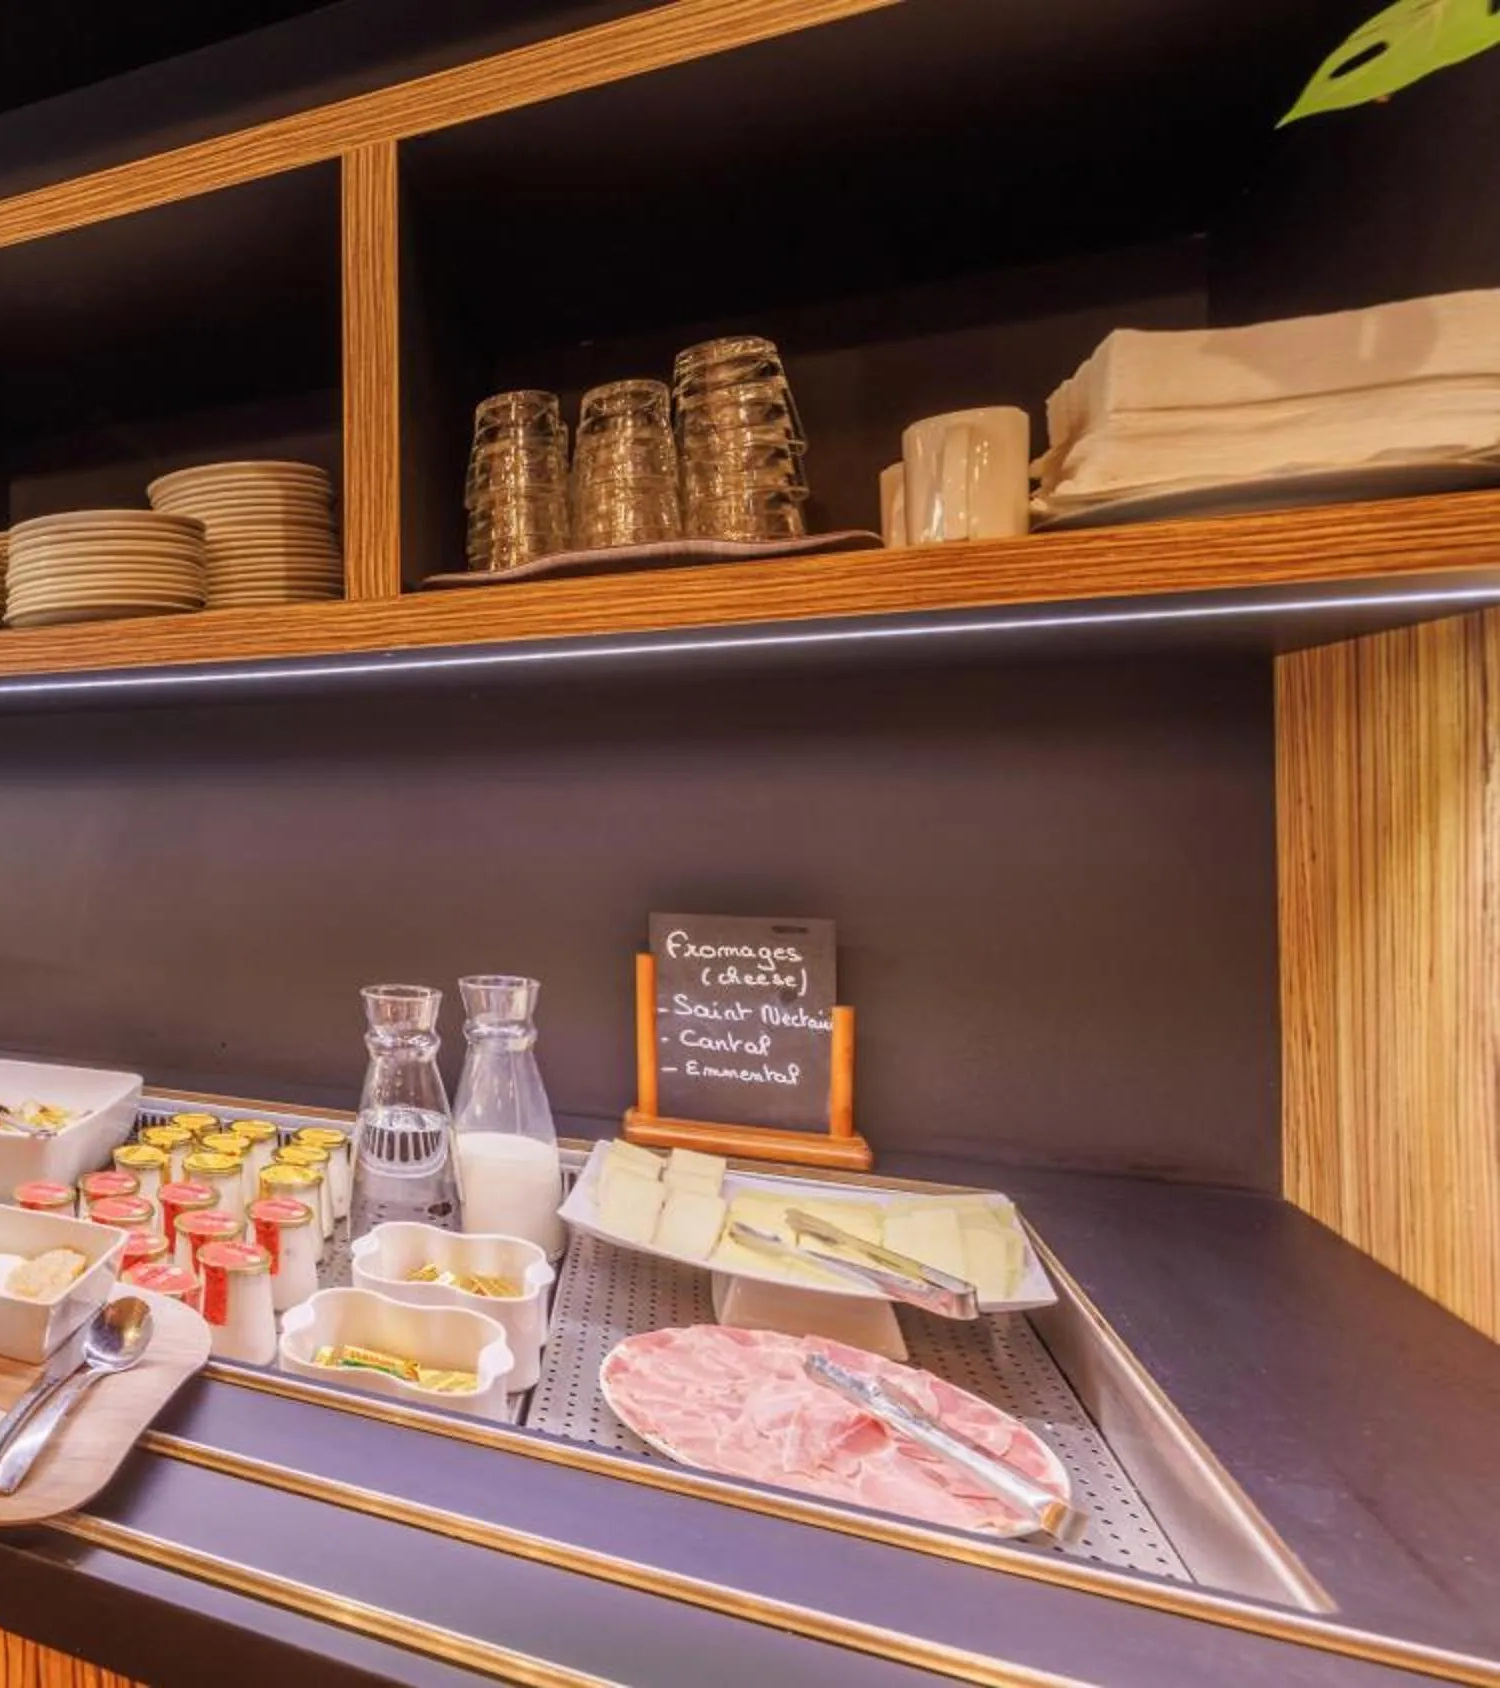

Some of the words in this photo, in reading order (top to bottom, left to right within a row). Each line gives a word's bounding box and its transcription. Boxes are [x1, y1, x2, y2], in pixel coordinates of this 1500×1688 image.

[665, 930, 803, 971] Fromages
[701, 966, 808, 997] (cheese)
[672, 993, 753, 1021] Saint
[679, 1030, 771, 1056] Cantal
[685, 1060, 801, 1085] Emmental
